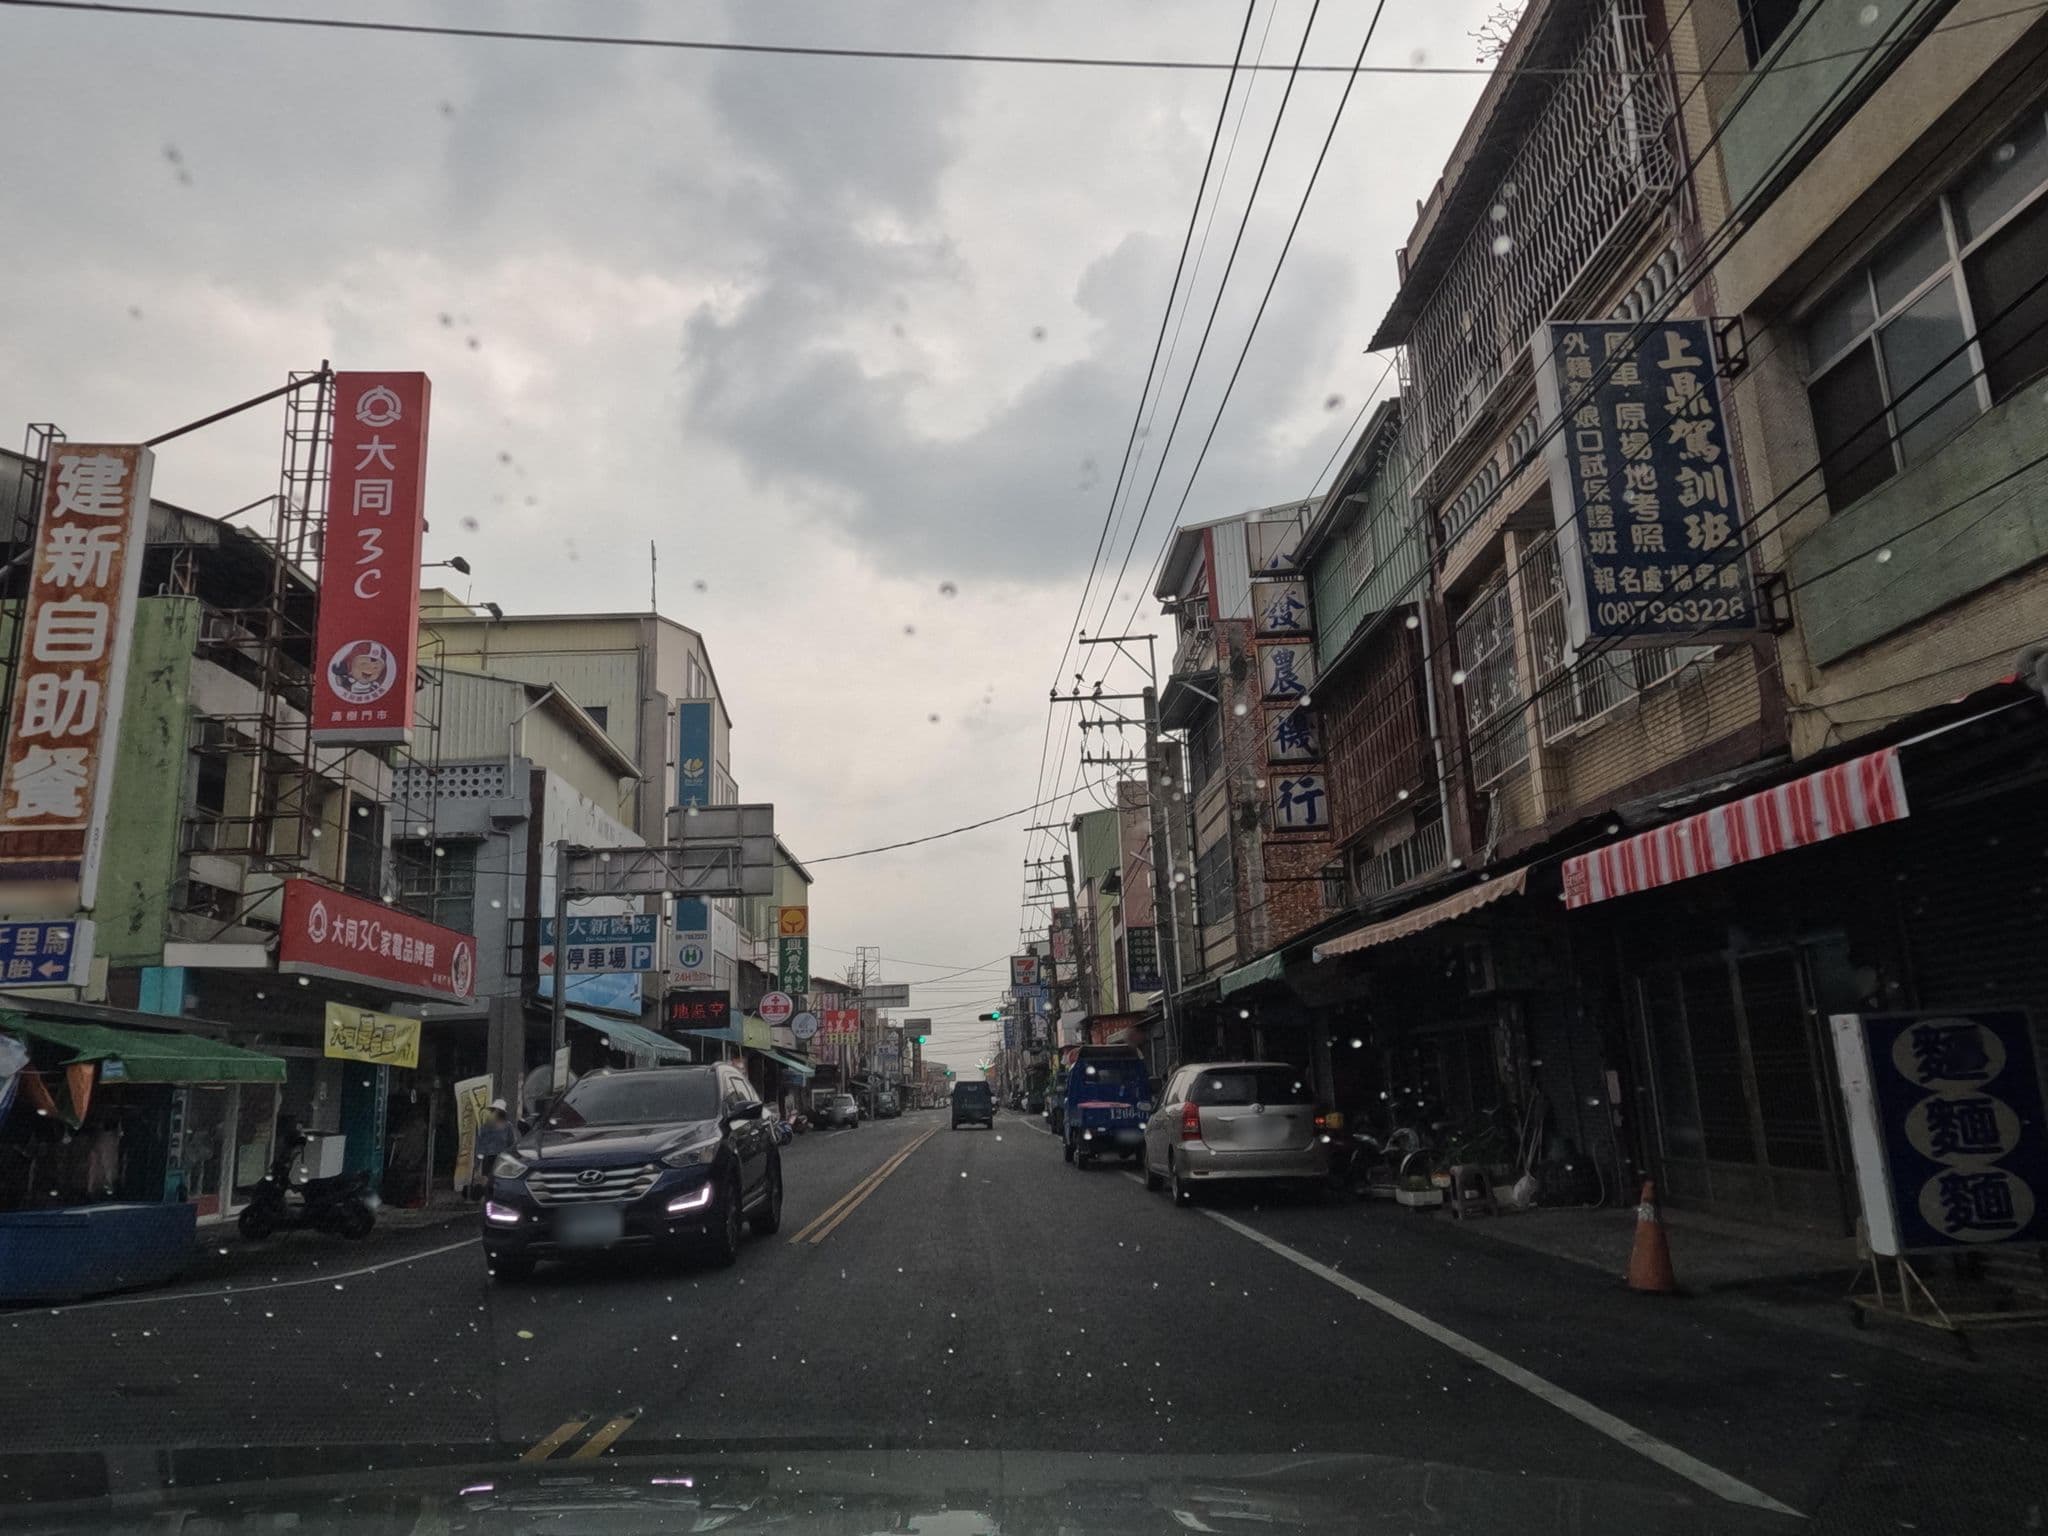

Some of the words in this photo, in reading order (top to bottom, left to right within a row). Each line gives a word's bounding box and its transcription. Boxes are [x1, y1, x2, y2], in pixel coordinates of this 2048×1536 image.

[1656, 329, 1740, 552] 上鼎駕訓班
[6, 451, 129, 821] 建新自助餐
[1596, 596, 1748, 627] (08)7963228
[1261, 552, 1326, 827] 發農機行
[567, 916, 652, 937] 大新醫院
[567, 945, 627, 970] 停車場
